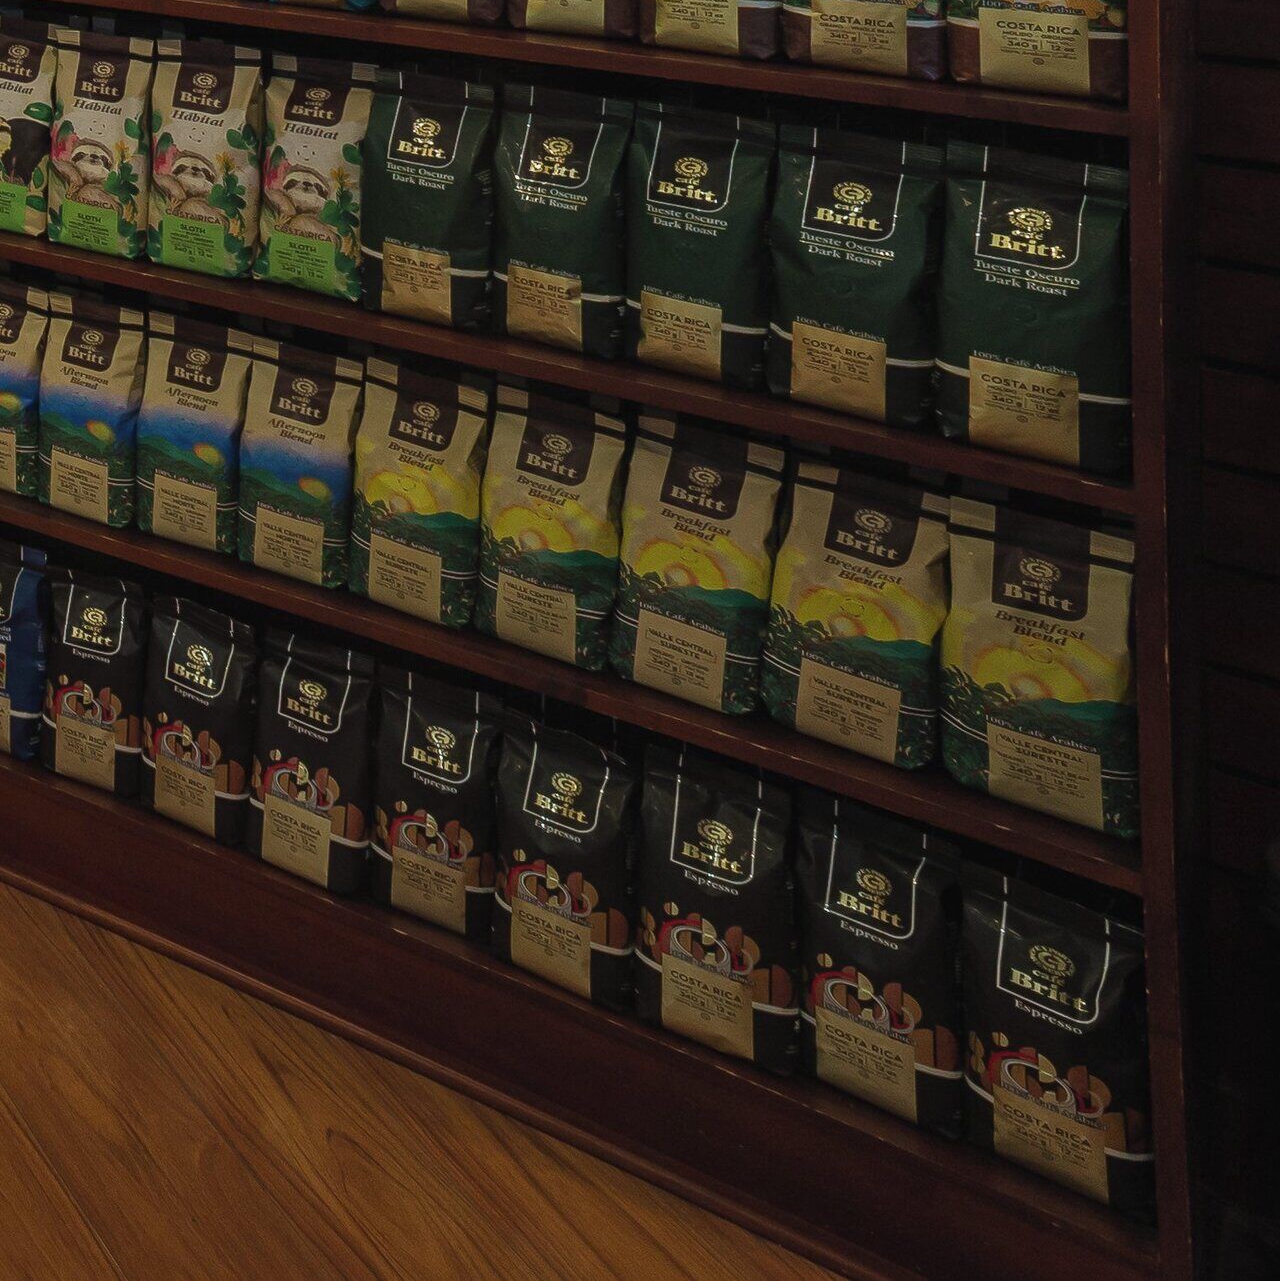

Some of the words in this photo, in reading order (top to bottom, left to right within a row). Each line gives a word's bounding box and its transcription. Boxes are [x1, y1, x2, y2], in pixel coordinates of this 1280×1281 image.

[985, 273, 1022, 288] Dark
[1026, 281, 1068, 297] Roast
[1025, 269, 1080, 286] Oscuro
[268, 417, 326, 441] Afternoon
[280, 429, 314, 445] Blend
[995, 610, 1086, 641] Breakfast
[1013, 624, 1067, 647] Blend
[1014, 998, 1083, 1035] Espresso
